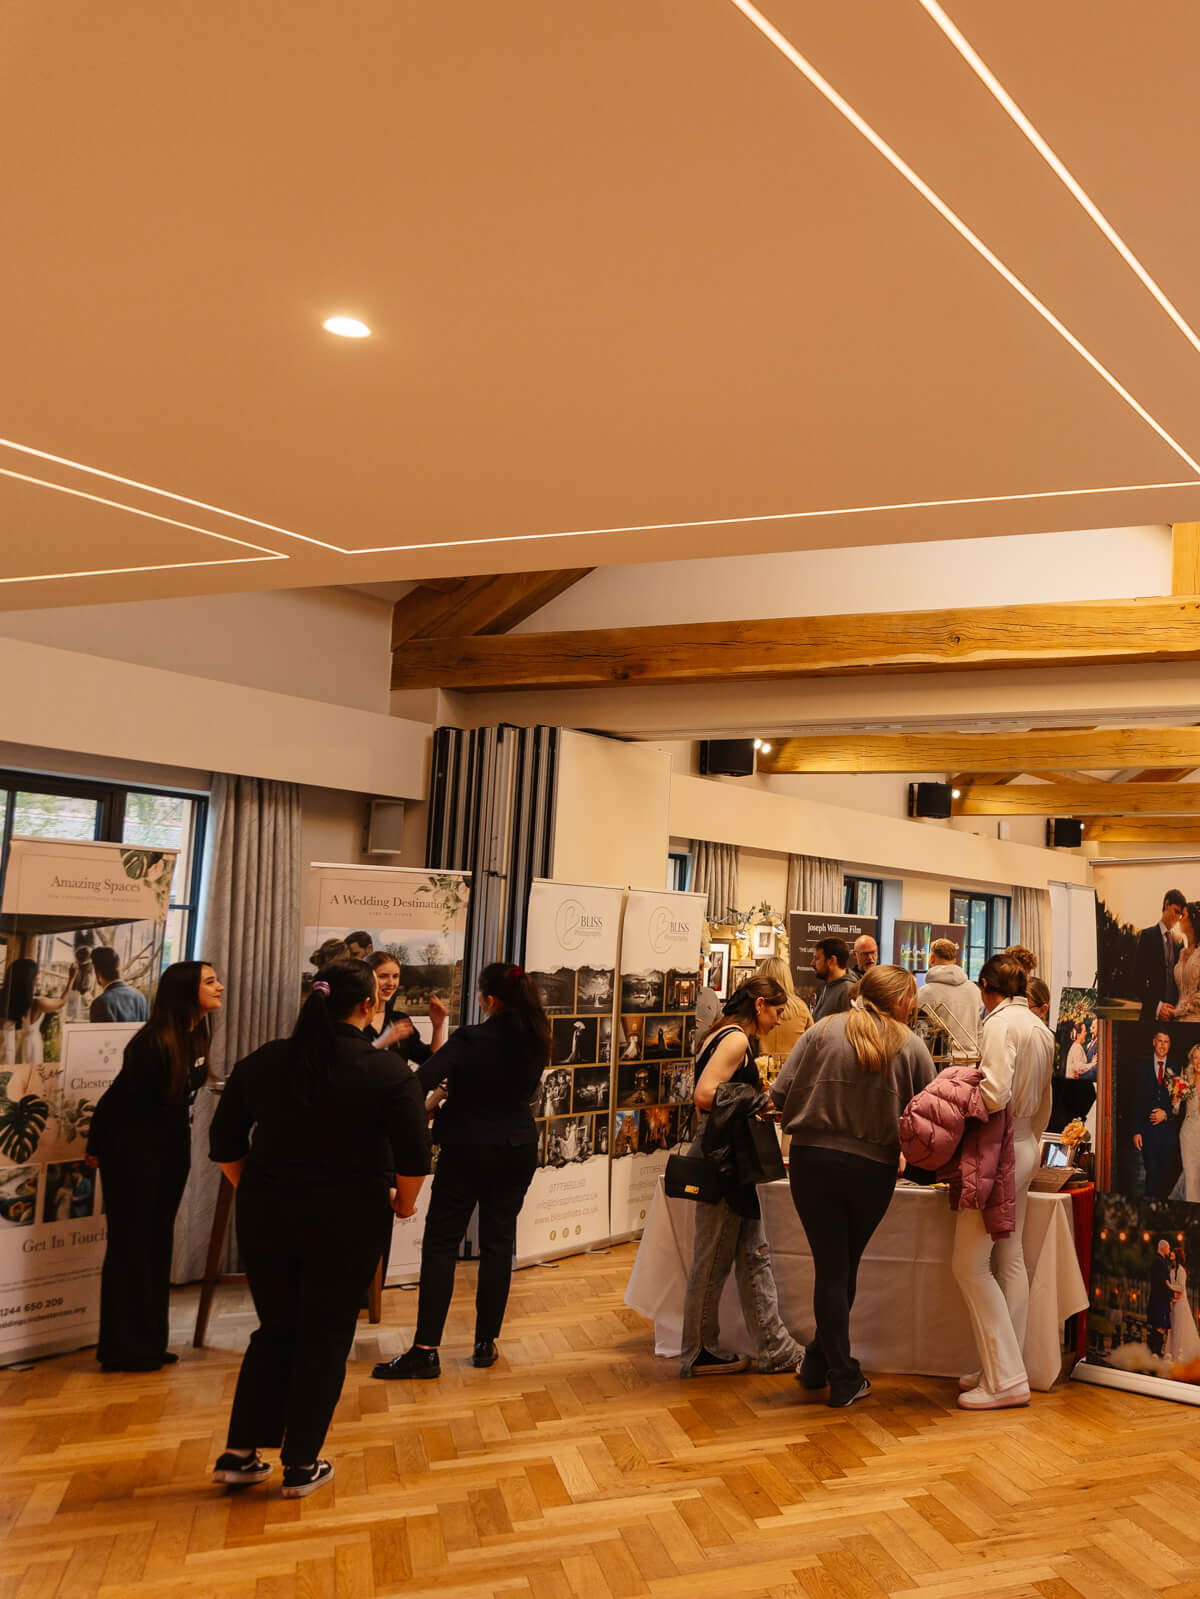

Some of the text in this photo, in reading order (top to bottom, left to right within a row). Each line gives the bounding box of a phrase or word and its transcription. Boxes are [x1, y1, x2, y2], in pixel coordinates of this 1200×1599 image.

[51, 876, 141, 894] Amazing Spaces
[329, 895, 447, 910] A Wedding Destination
[580, 914, 603, 928] BLISS
[807, 922, 826, 935] Joseph
[827, 923, 848, 934] William
[23, 1239, 46, 1253] Get
[52, 1235, 65, 1249] In
[24, 1300, 43, 1313] 650
